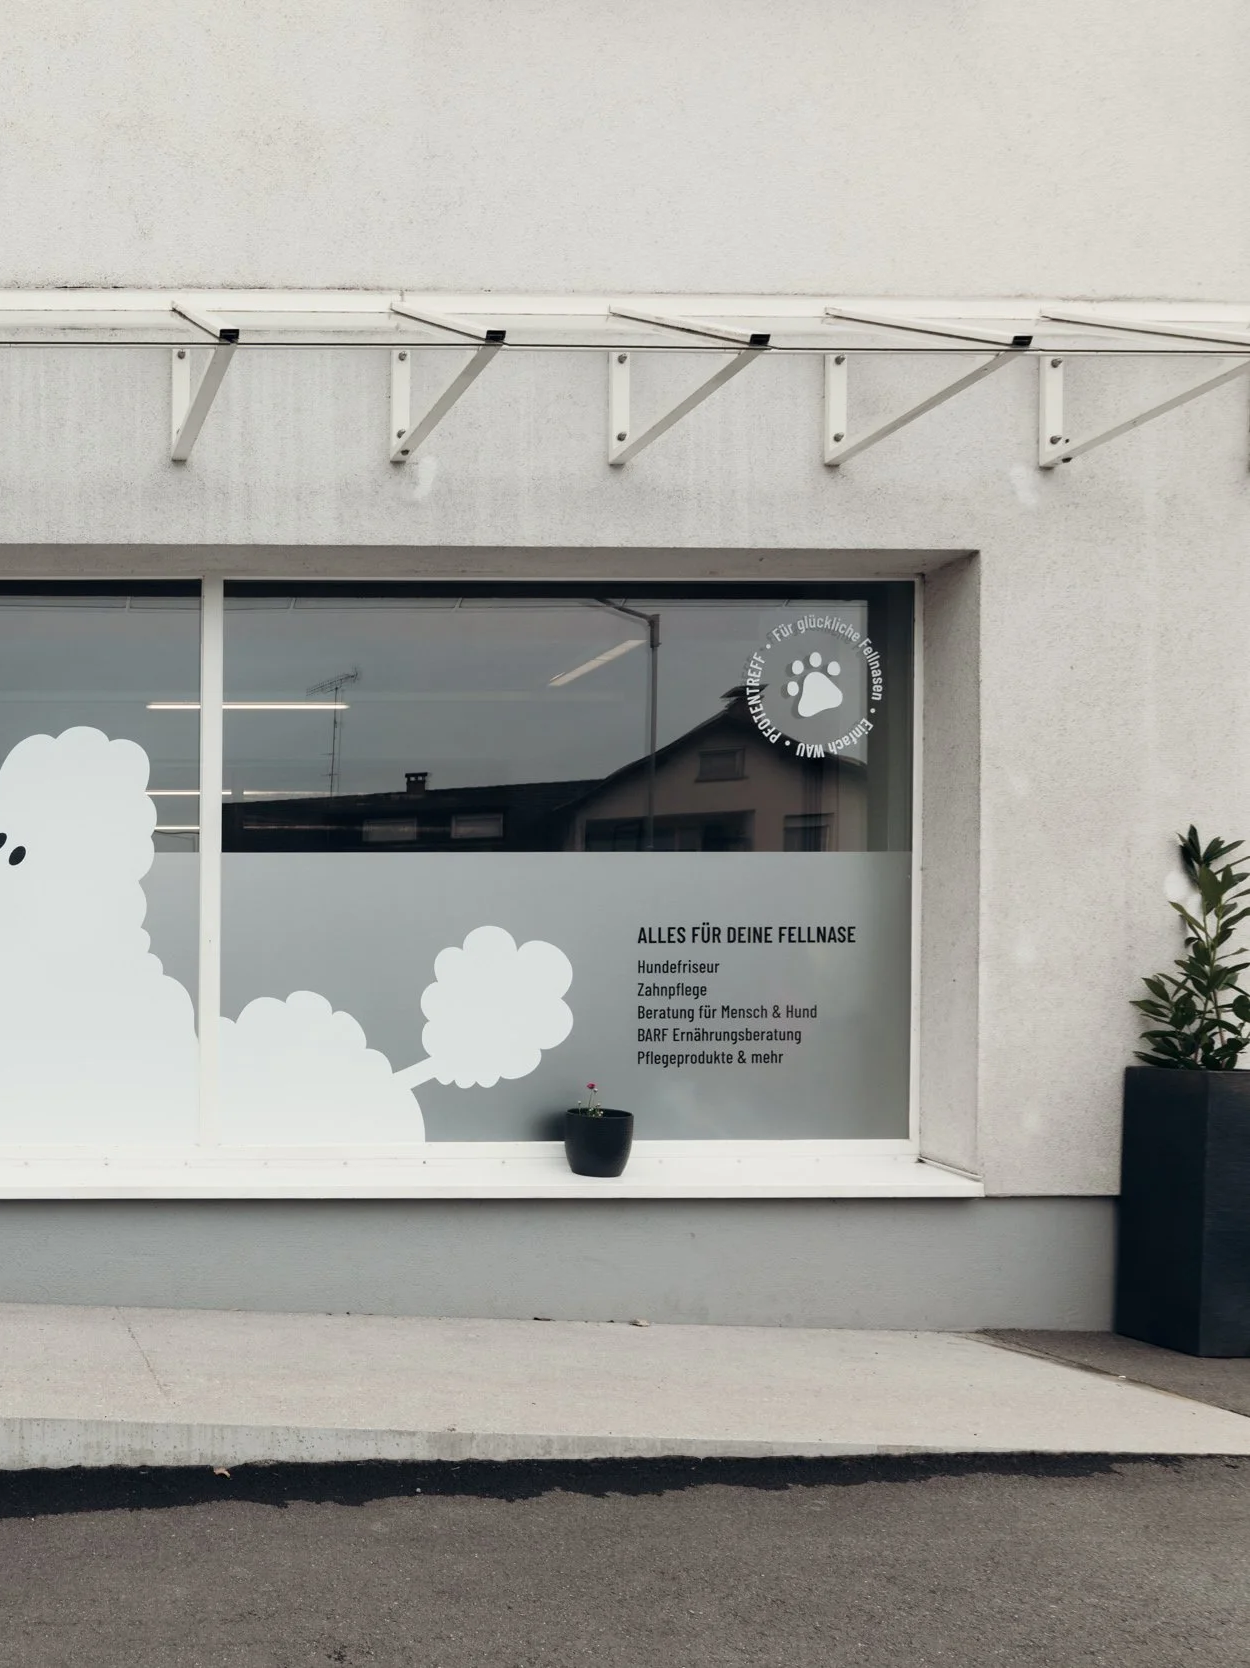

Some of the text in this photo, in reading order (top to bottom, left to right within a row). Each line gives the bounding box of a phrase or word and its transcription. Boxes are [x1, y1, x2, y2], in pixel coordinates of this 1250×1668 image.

[771, 614, 884, 701] Für glückliche Fellnasen
[746, 652, 782, 744] PFOTENTREFF
[795, 717, 874, 758] Einfach WAU
[637, 922, 856, 944] ALLES FÜR DEINE FELLNASE
[637, 959, 720, 974] Hundefriseur
[637, 982, 707, 1000] Zahnpflege
[637, 1005, 818, 1022] Beratung für Mensch & Hund
[637, 1027, 801, 1045] BARF Ernährungsberatung
[637, 1050, 784, 1068] Pflegeprodukte & mehr
